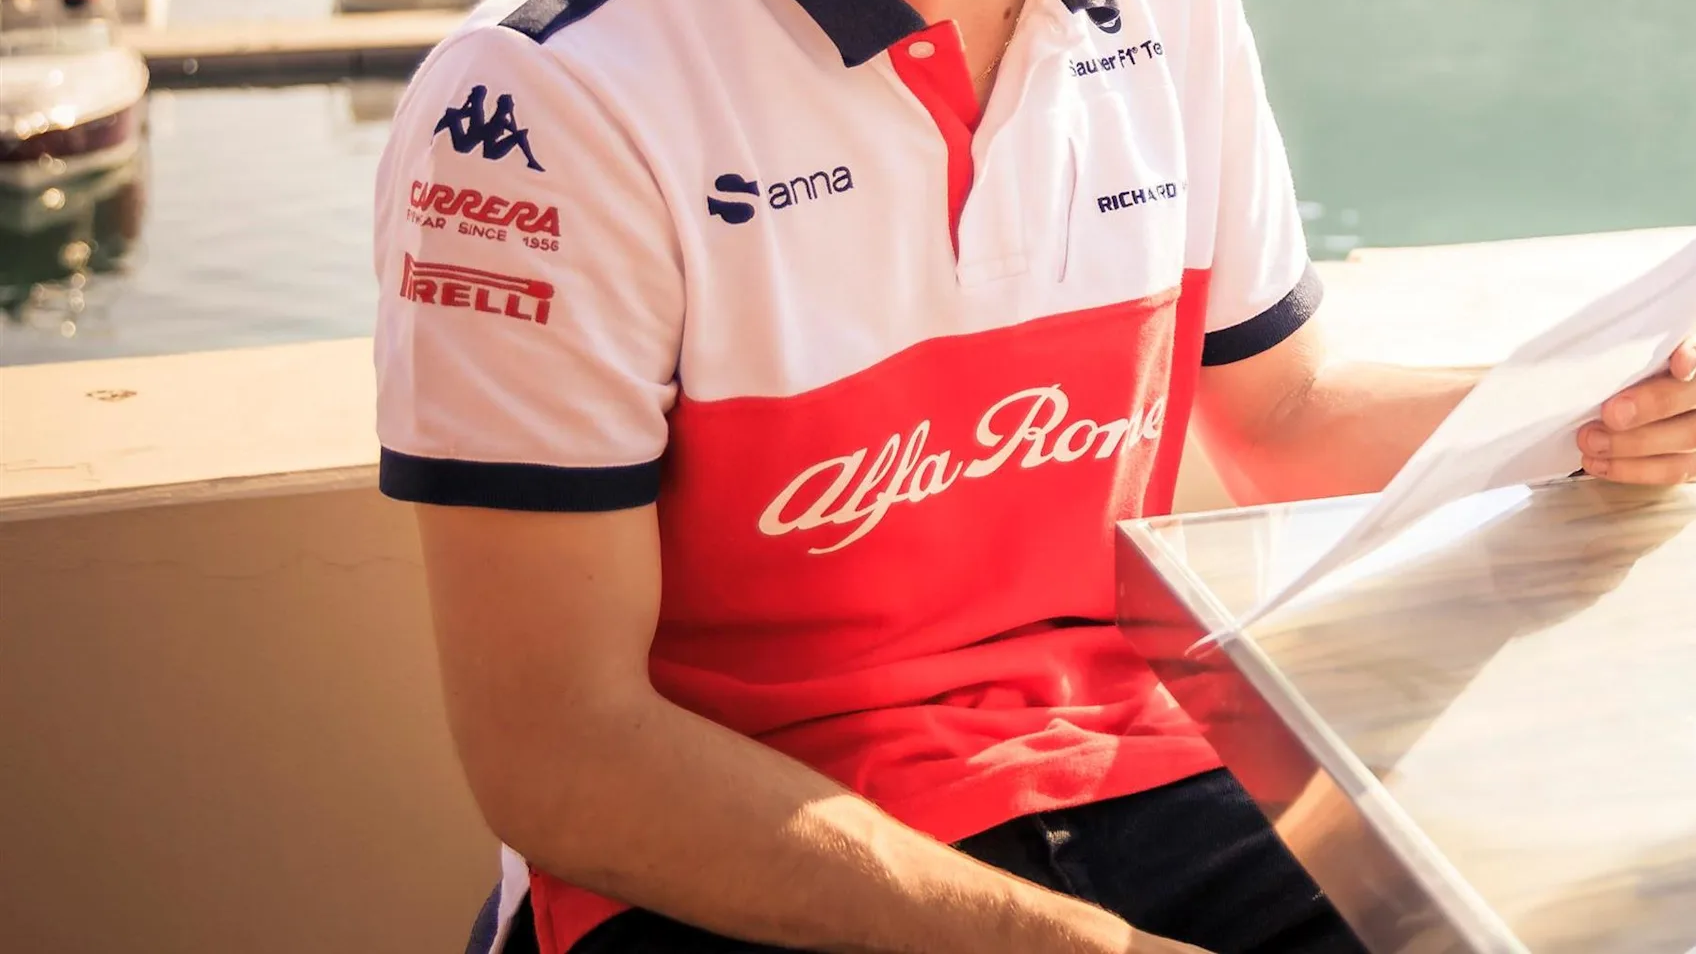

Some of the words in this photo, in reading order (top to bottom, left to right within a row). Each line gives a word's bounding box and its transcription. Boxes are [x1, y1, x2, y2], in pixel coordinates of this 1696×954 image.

[1097, 181, 1177, 214] RICHARD
[457, 221, 508, 242] SINCE
[522, 236, 560, 252] 1956
[758, 419, 964, 556] Alfa
[962, 383, 1167, 478] Rome
